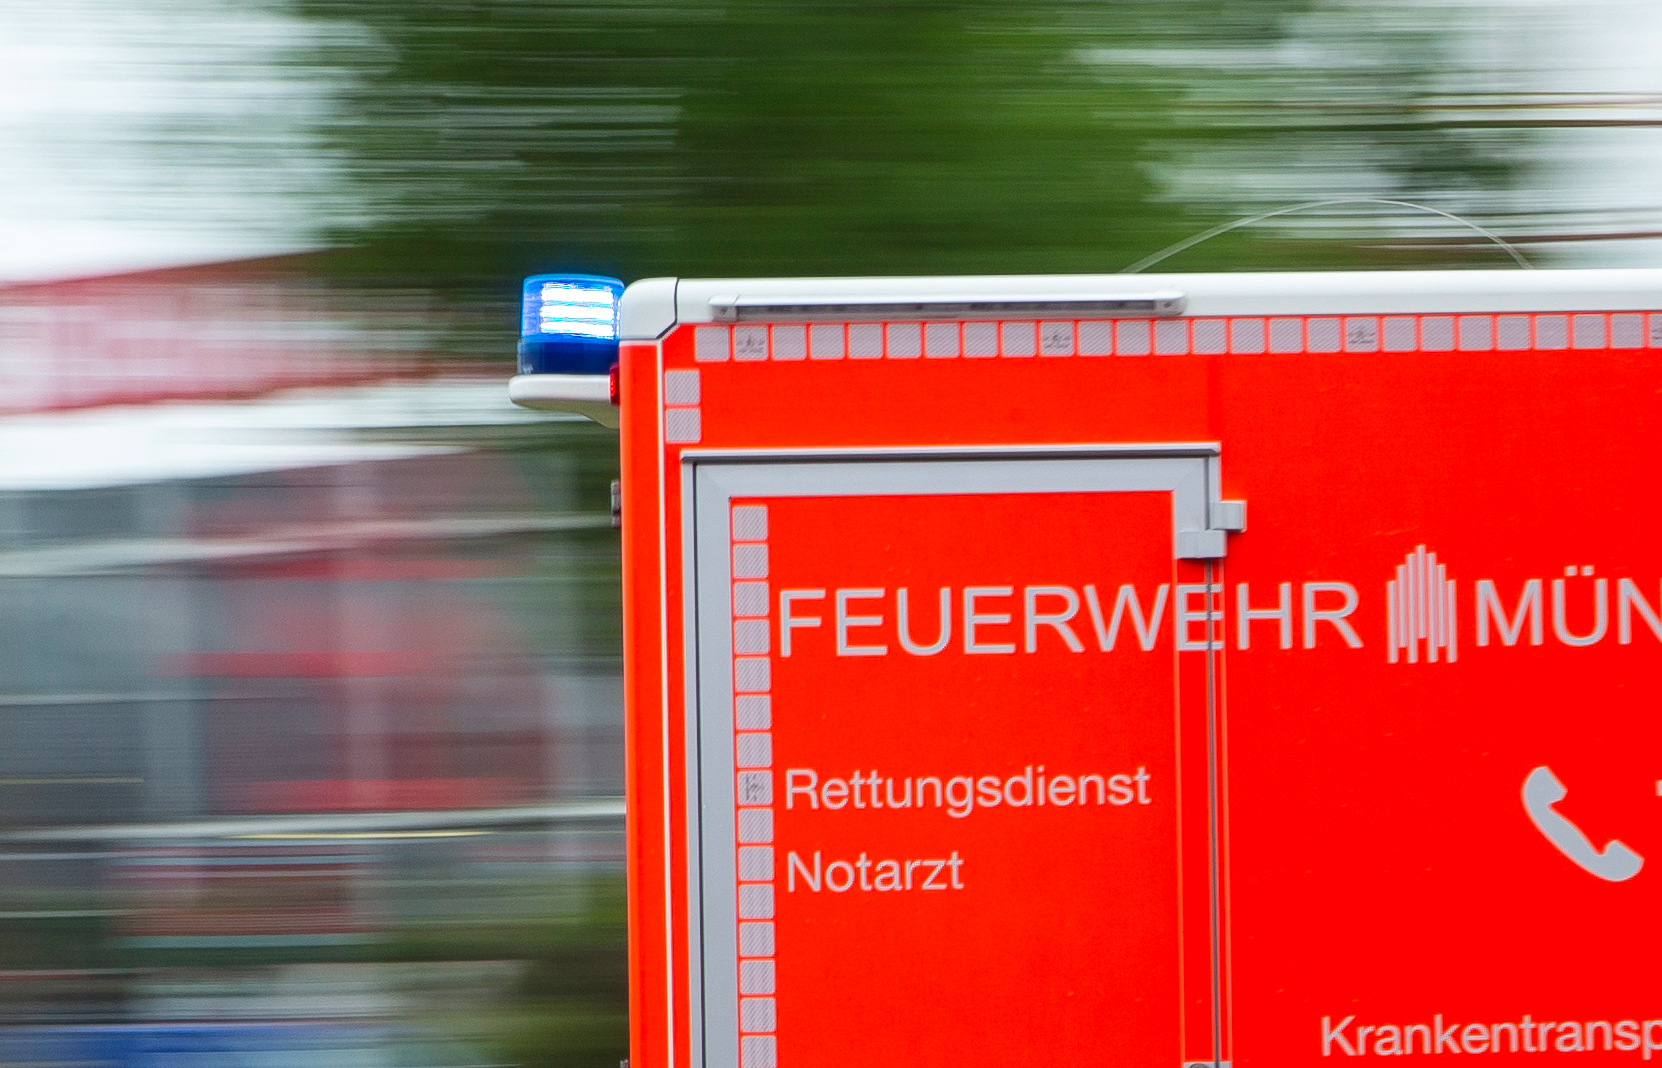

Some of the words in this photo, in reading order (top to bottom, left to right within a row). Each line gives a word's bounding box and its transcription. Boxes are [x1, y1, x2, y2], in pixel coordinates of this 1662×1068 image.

[779, 579, 1363, 659] FEUERWEHR
[785, 764, 1151, 819] Rettungsdienst
[787, 850, 965, 893] Notarzt
